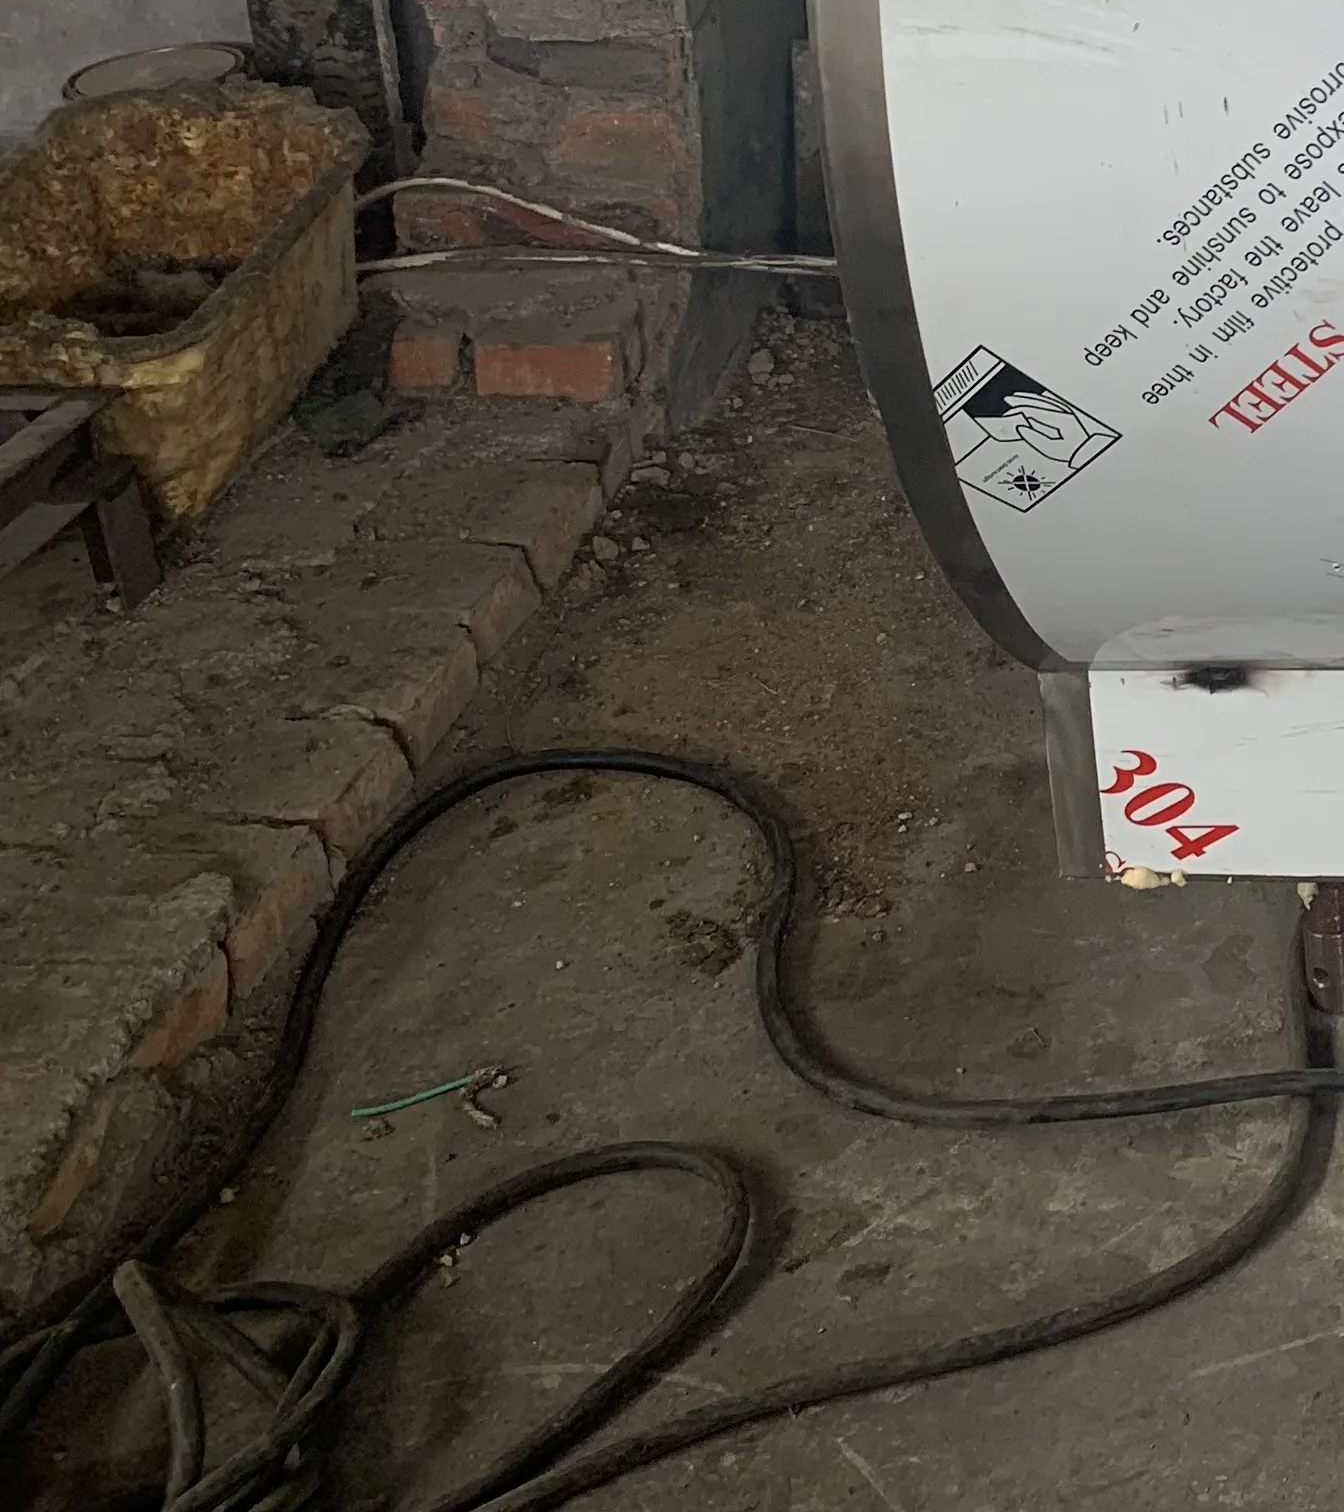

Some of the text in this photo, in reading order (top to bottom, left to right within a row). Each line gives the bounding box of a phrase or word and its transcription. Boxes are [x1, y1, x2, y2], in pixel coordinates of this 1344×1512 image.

[1155, 141, 1272, 247] substances.
[1256, 181, 1288, 206] to
[1279, 179, 1343, 233] leave
[1170, 205, 1258, 287] sunshine
[1242, 234, 1285, 268] the
[1249, 218, 1344, 309] protective
[1128, 287, 1172, 330] and
[1172, 266, 1250, 329] factory.
[1082, 322, 1139, 367] keep
[1210, 308, 1256, 343] film
[1187, 342, 1220, 364] in
[1140, 363, 1196, 405] three
[1098, 748, 1241, 863] 304
